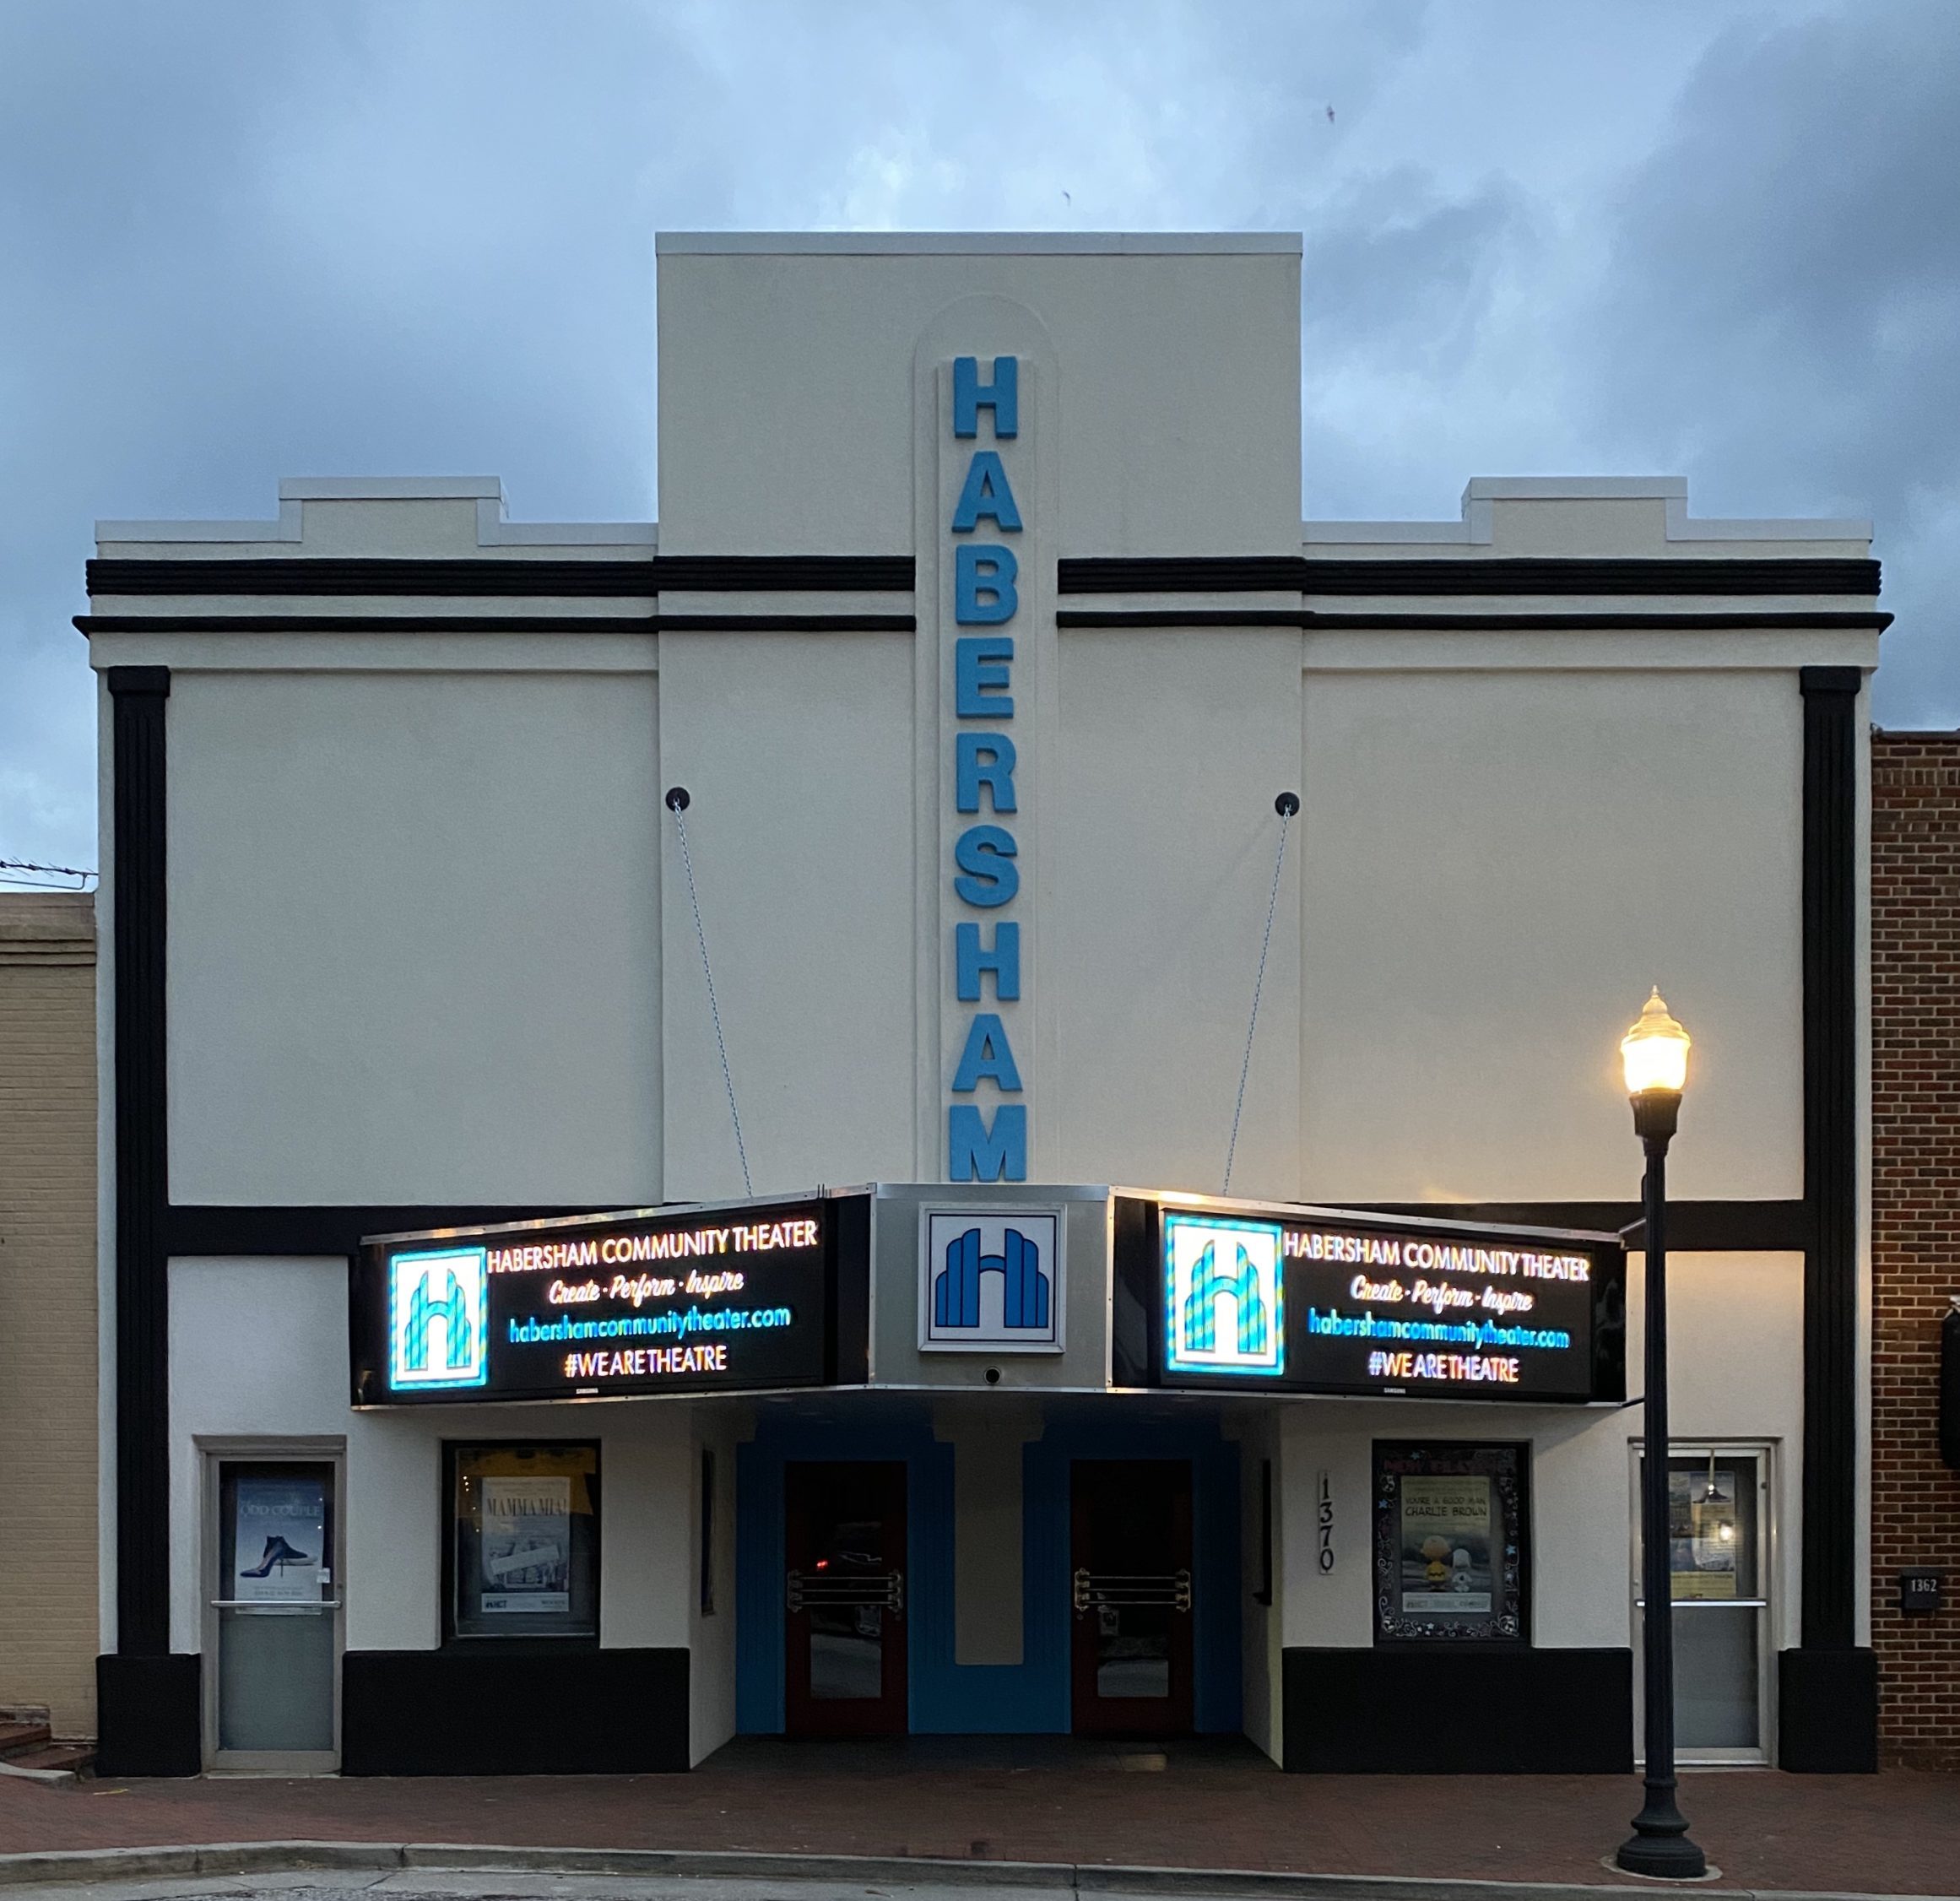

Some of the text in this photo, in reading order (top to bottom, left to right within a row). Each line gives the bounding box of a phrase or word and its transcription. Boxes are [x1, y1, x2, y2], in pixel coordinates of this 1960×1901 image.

[949, 355, 1027, 1182] HABERSHAM
[486, 1220, 819, 1275] HABERSHAM COMMUNITY THEATER
[1283, 1232, 1590, 1281] HABERSHAM COMMUNITY THEATER
[549, 1269, 744, 1308] Create Perform Inspire
[1351, 1275, 1533, 1315] Create Perform Inspire
[509, 1305, 791, 1343] habershamcommunitytheater.com
[1308, 1307, 1570, 1350] habershamcommunitytheater.com
[486, 1498, 536, 1517] MAMMA
[1319, 1476, 1334, 1573] 1370
[1405, 1506, 1487, 1517] CHARLIE BROWN
[1911, 1578, 1937, 1593] 1362
